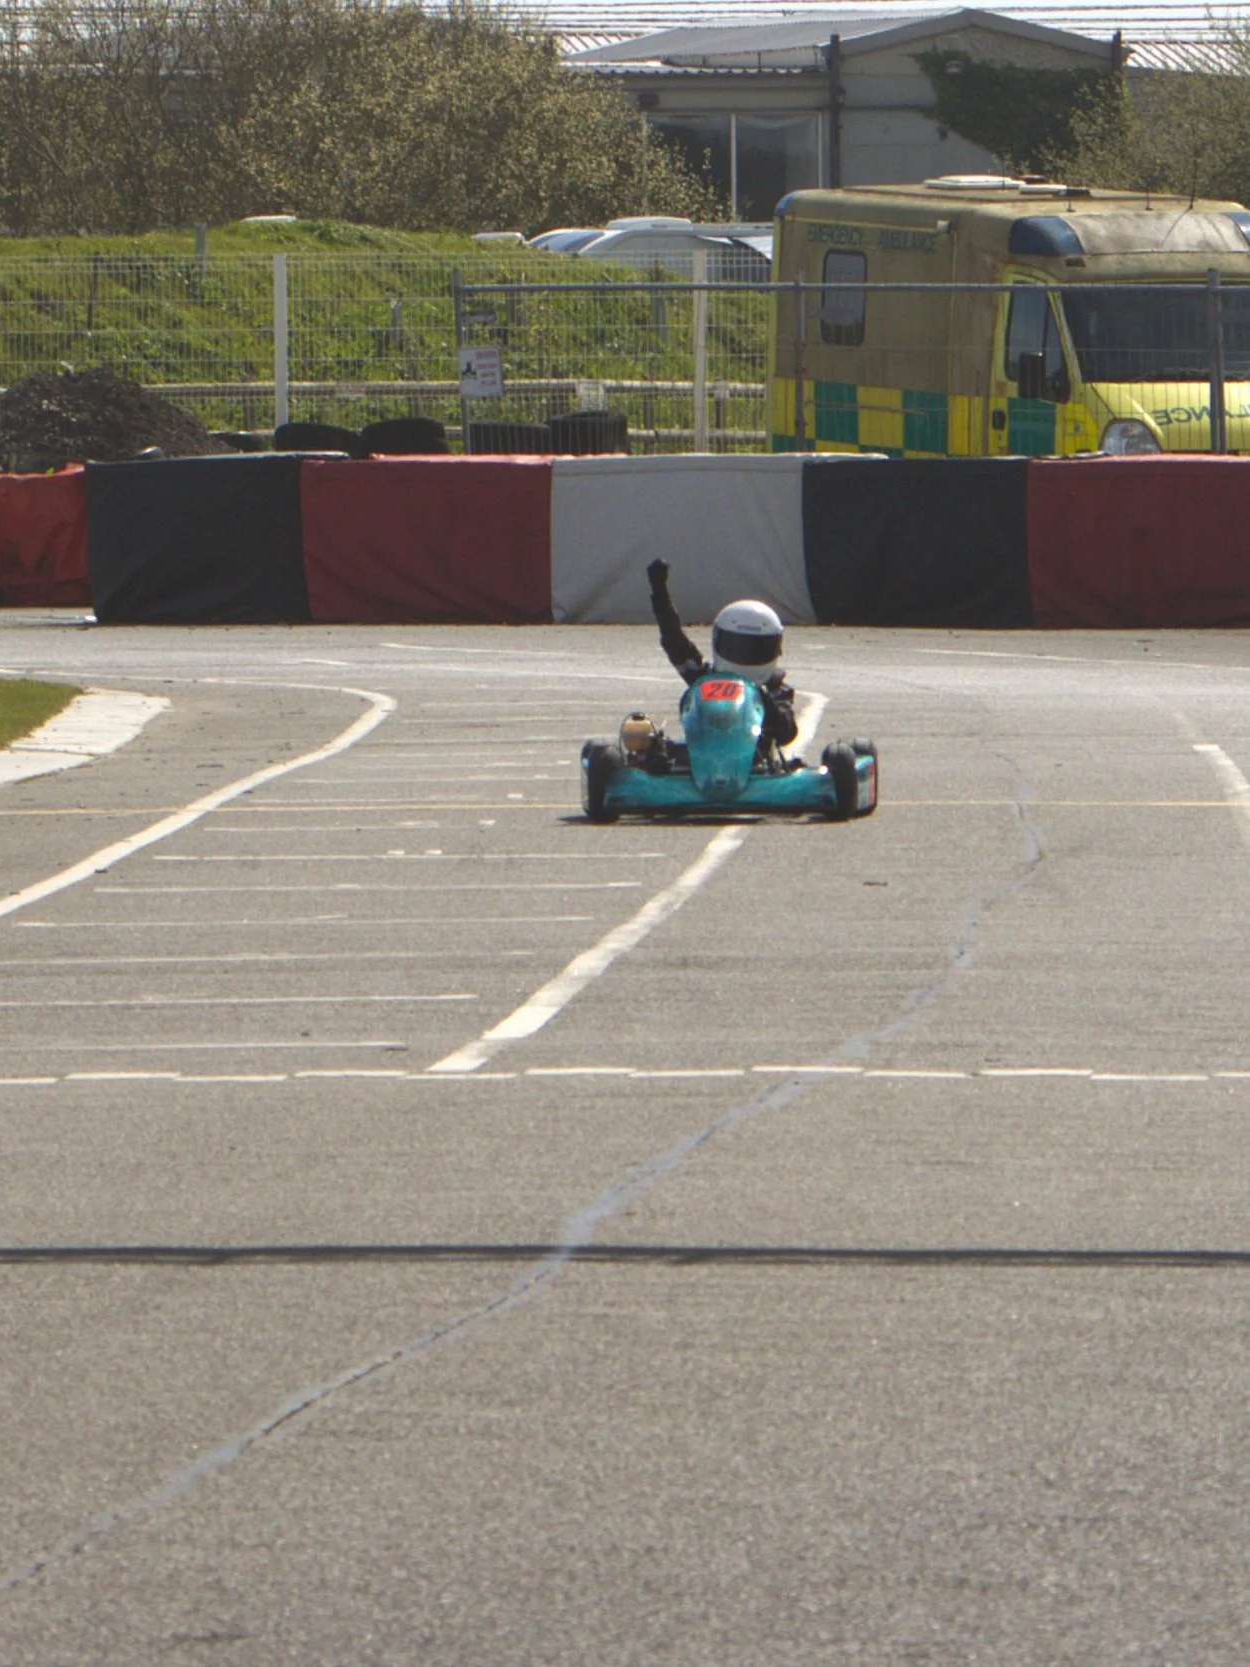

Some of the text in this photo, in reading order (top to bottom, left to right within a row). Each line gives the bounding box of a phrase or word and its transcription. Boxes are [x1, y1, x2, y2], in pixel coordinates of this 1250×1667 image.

[808, 225, 936, 253] EMERGENCY AMBULANCE
[707, 682, 737, 697] 20
